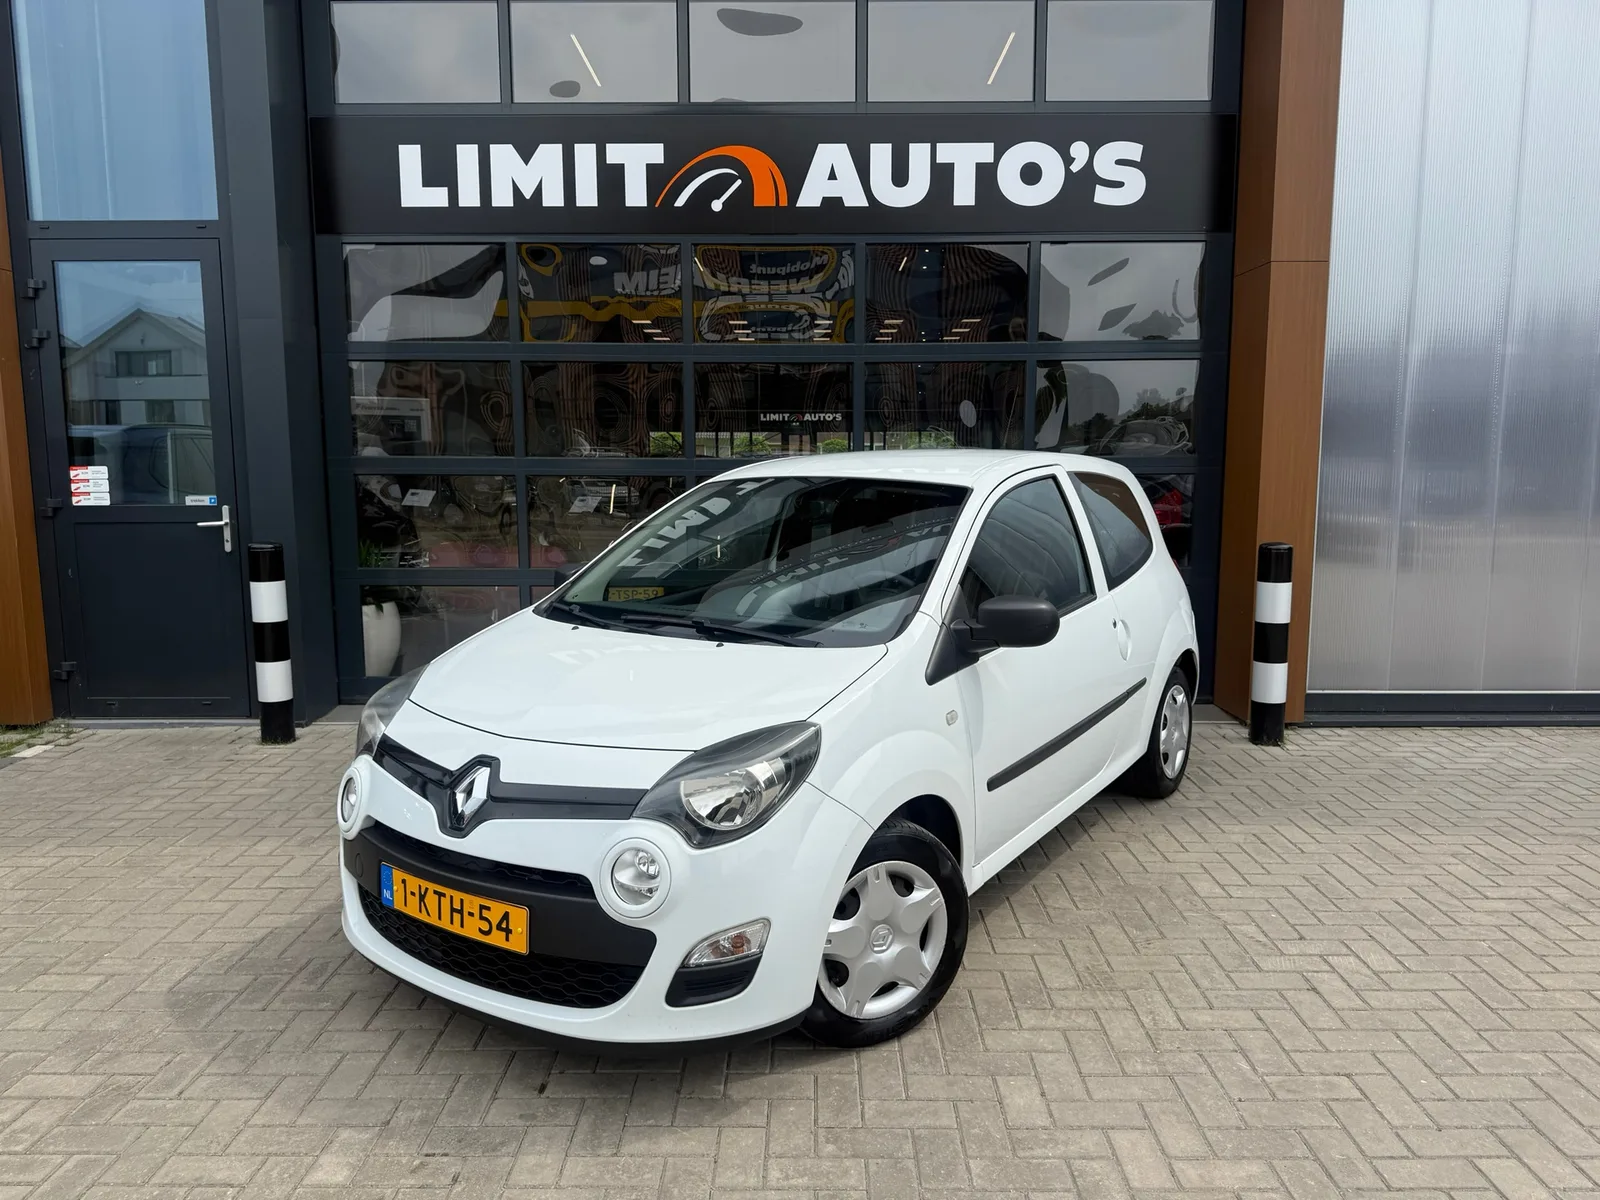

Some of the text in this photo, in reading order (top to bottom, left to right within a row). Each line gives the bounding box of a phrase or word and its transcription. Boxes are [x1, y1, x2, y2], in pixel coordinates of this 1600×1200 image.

[398, 140, 1147, 208] LIMIT AUTO'S
[760, 413, 842, 421] LIMIT AUTO'S
[608, 589, 659, 600] -TSP-59
[383, 888, 393, 901] NL
[401, 878, 513, 943] 1-KTH-54
